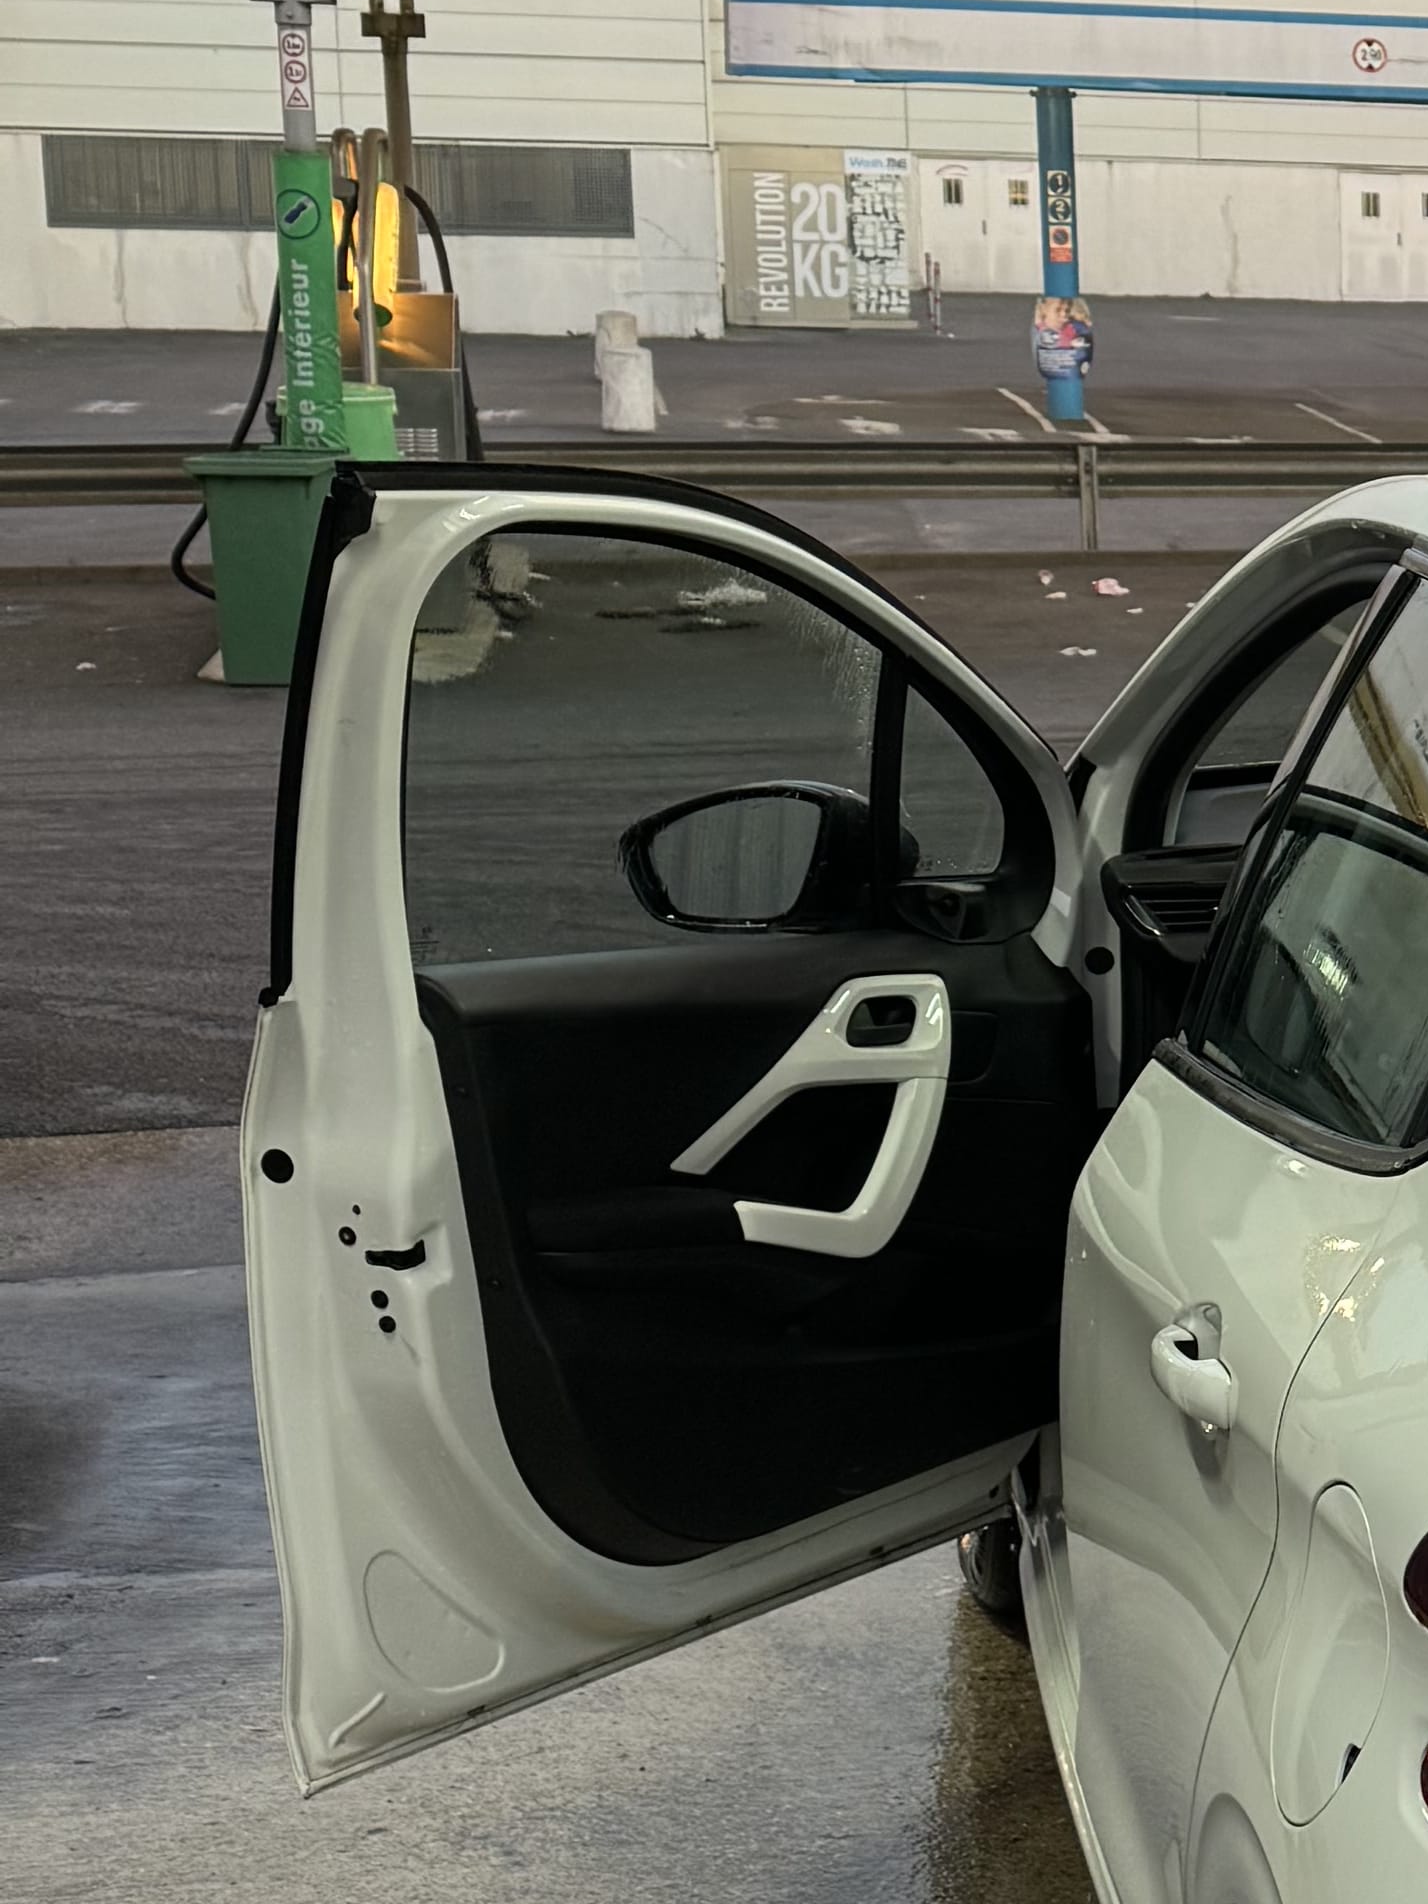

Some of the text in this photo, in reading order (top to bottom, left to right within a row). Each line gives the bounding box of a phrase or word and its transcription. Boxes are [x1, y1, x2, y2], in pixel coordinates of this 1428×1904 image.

[1055, 174, 1064, 186] 1
[1055, 200, 1065, 212] 2
[791, 182, 847, 242] 20
[753, 172, 790, 312] REVOLUTION
[793, 243, 850, 298] KG
[287, 259, 315, 387] Intérieur
